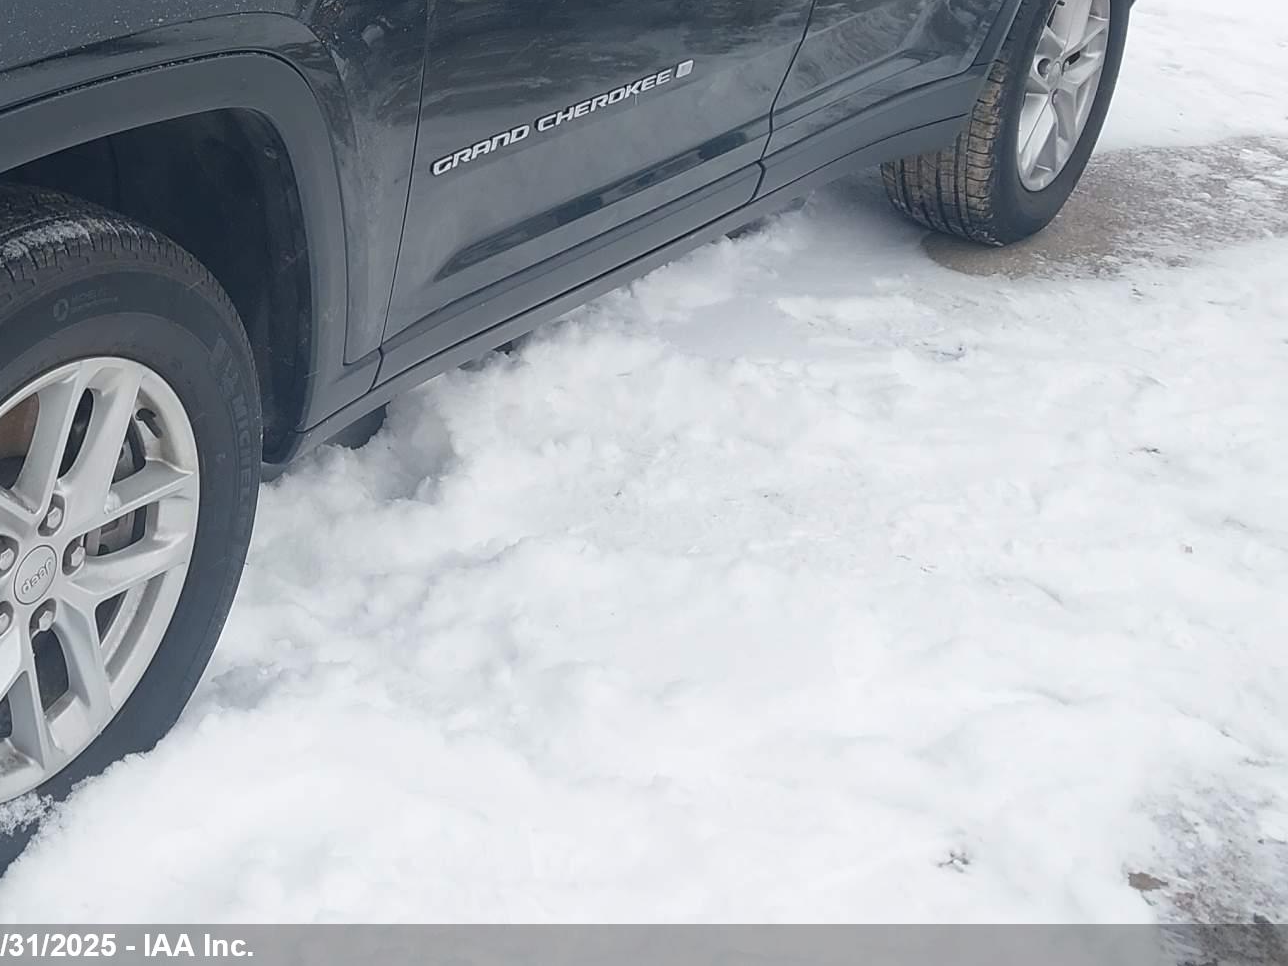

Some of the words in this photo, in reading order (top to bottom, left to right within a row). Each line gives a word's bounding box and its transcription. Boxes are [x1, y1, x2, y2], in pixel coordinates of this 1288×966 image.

[431, 124, 530, 176] GRAND
[536, 68, 673, 132] CHEROKEE
[21, 557, 53, 595] Jeep
